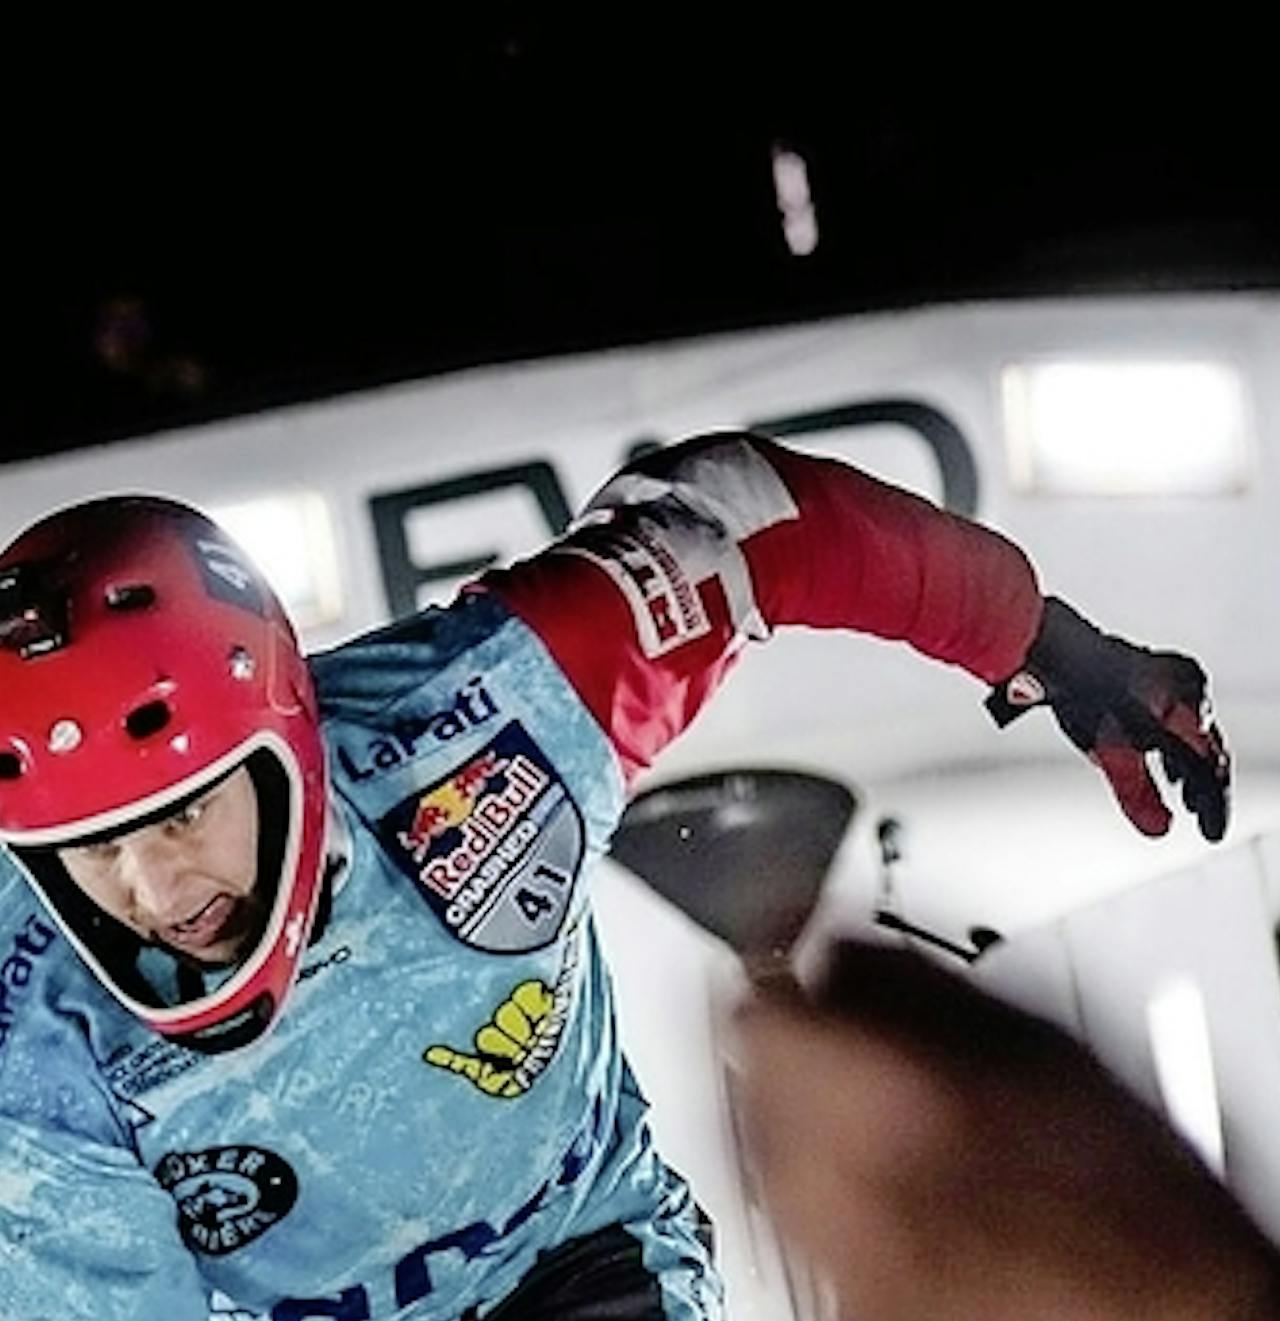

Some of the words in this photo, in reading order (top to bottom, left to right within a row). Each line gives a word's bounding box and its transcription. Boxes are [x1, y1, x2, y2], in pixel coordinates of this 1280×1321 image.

[421, 821, 493, 899] Red
[477, 757, 549, 839] Bull
[515, 864, 568, 922] 41
